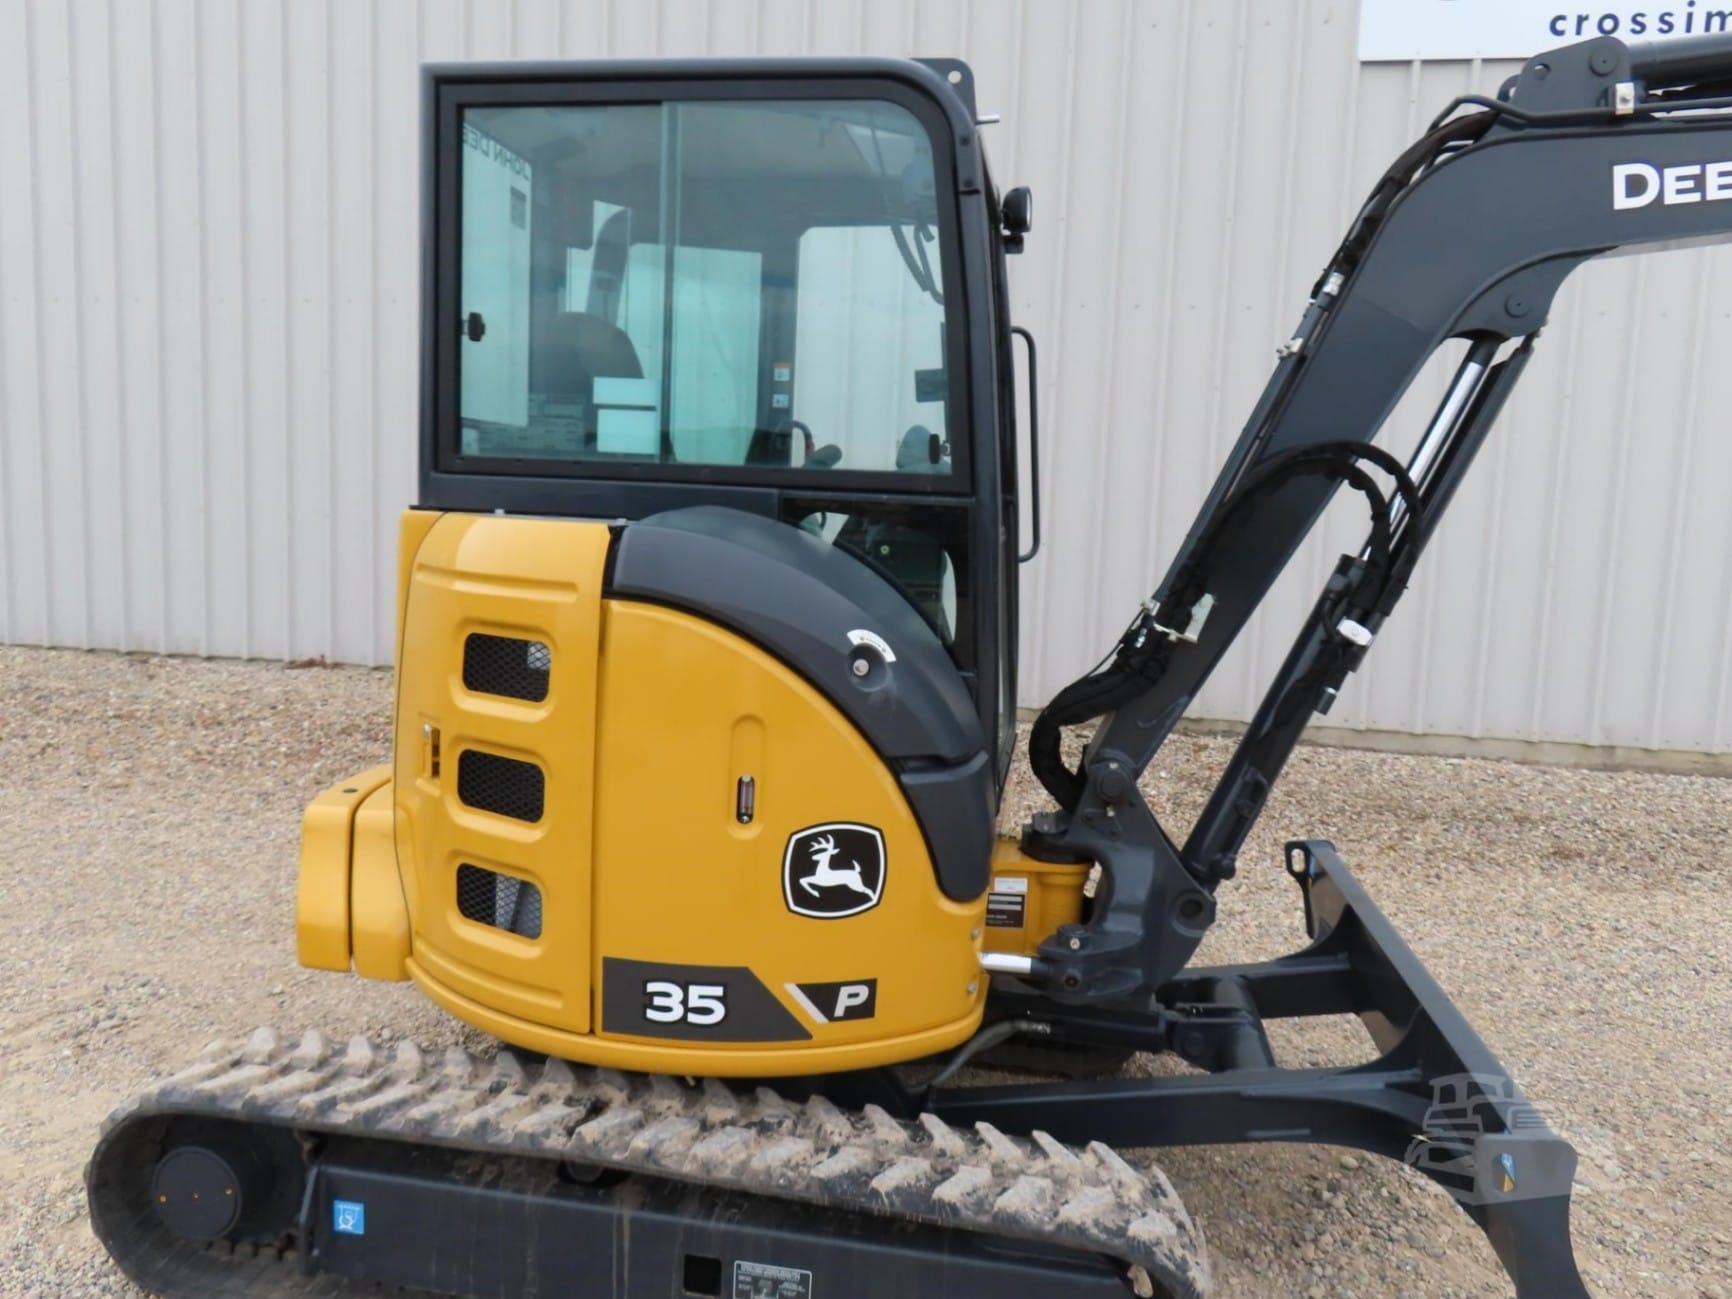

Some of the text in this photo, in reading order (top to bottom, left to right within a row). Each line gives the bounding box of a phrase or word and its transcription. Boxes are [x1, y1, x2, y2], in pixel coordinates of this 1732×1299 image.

[1613, 162, 1732, 211] DEE
[646, 982, 726, 1024] 35
[834, 984, 869, 1018] P
